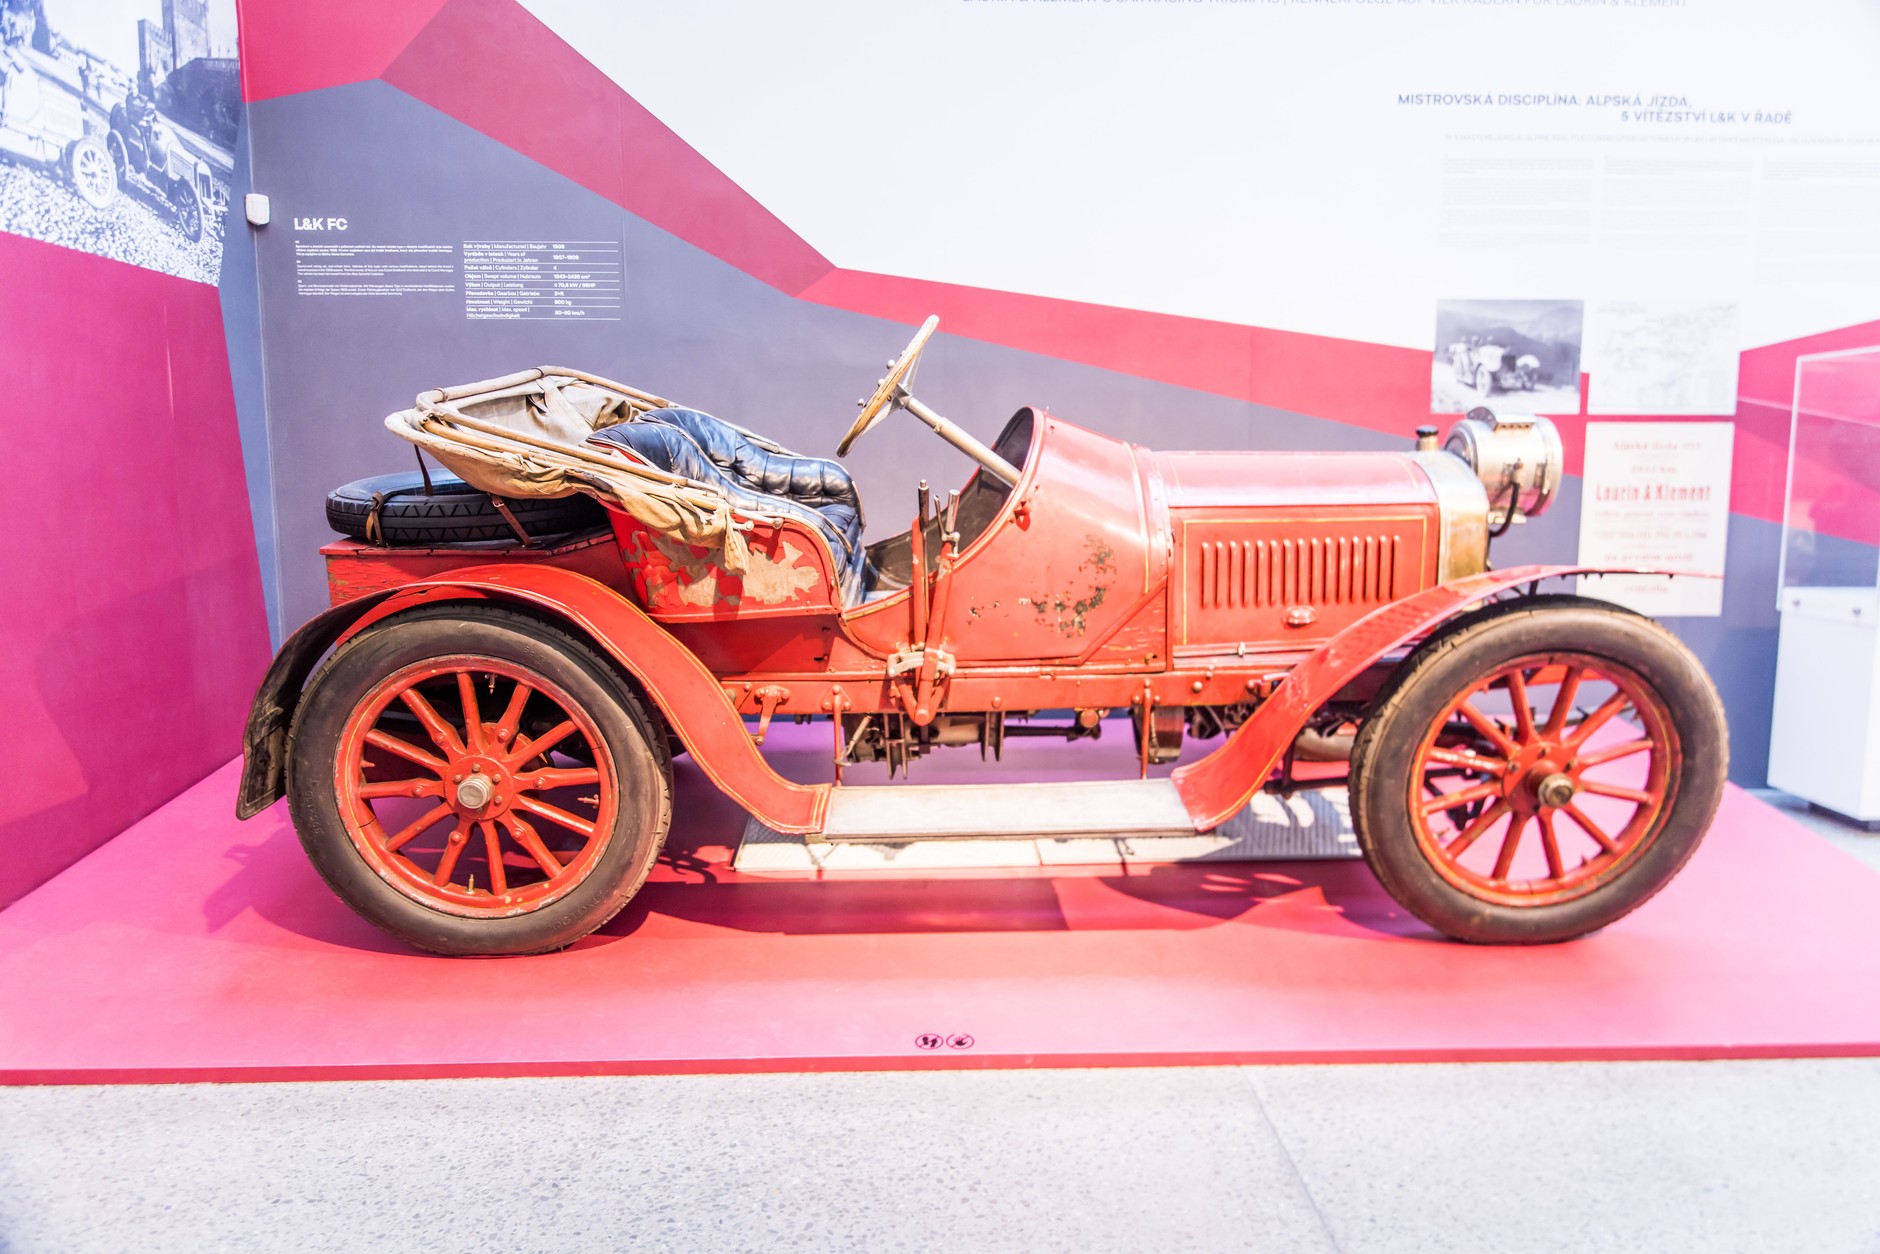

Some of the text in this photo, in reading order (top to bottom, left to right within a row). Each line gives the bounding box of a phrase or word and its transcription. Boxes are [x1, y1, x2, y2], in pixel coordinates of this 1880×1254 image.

[1398, 92, 1494, 105] MISTROVSKÁ
[1586, 93, 1642, 106] ALPSKÁ
[1621, 111, 1629, 122] 5
[1710, 111, 1736, 123] L&K
[1741, 112, 1750, 123] V
[293, 217, 348, 231] L&K FC
[1596, 484, 1639, 501] Laurin
[1656, 484, 1711, 501] Klement
